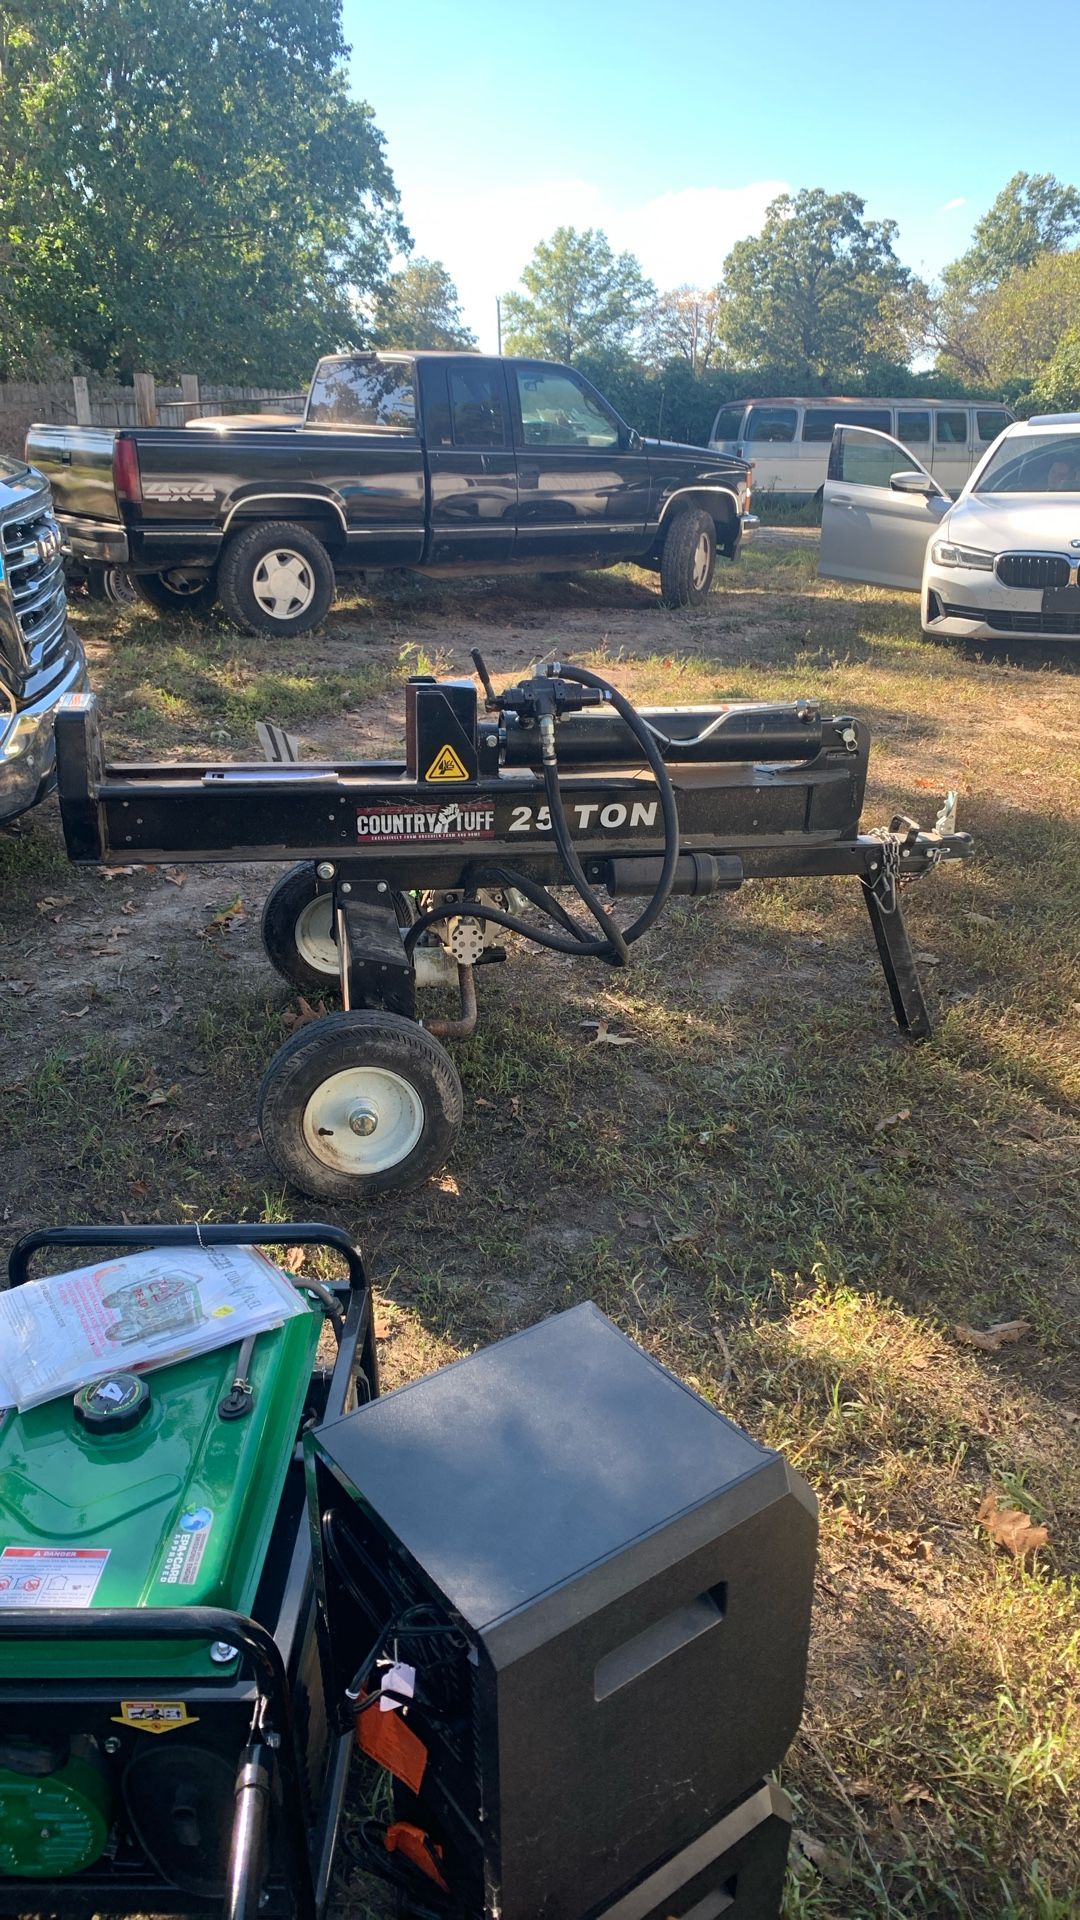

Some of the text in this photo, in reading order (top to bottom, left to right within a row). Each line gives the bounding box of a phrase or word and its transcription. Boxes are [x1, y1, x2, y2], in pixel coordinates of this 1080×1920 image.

[357, 811, 494, 835] COUNTRY TUFF
[508, 802, 658, 831] 25 TON
[371, 833, 402, 841] EXCLUSIVELY
[160, 1534, 181, 1582] APPROVED
